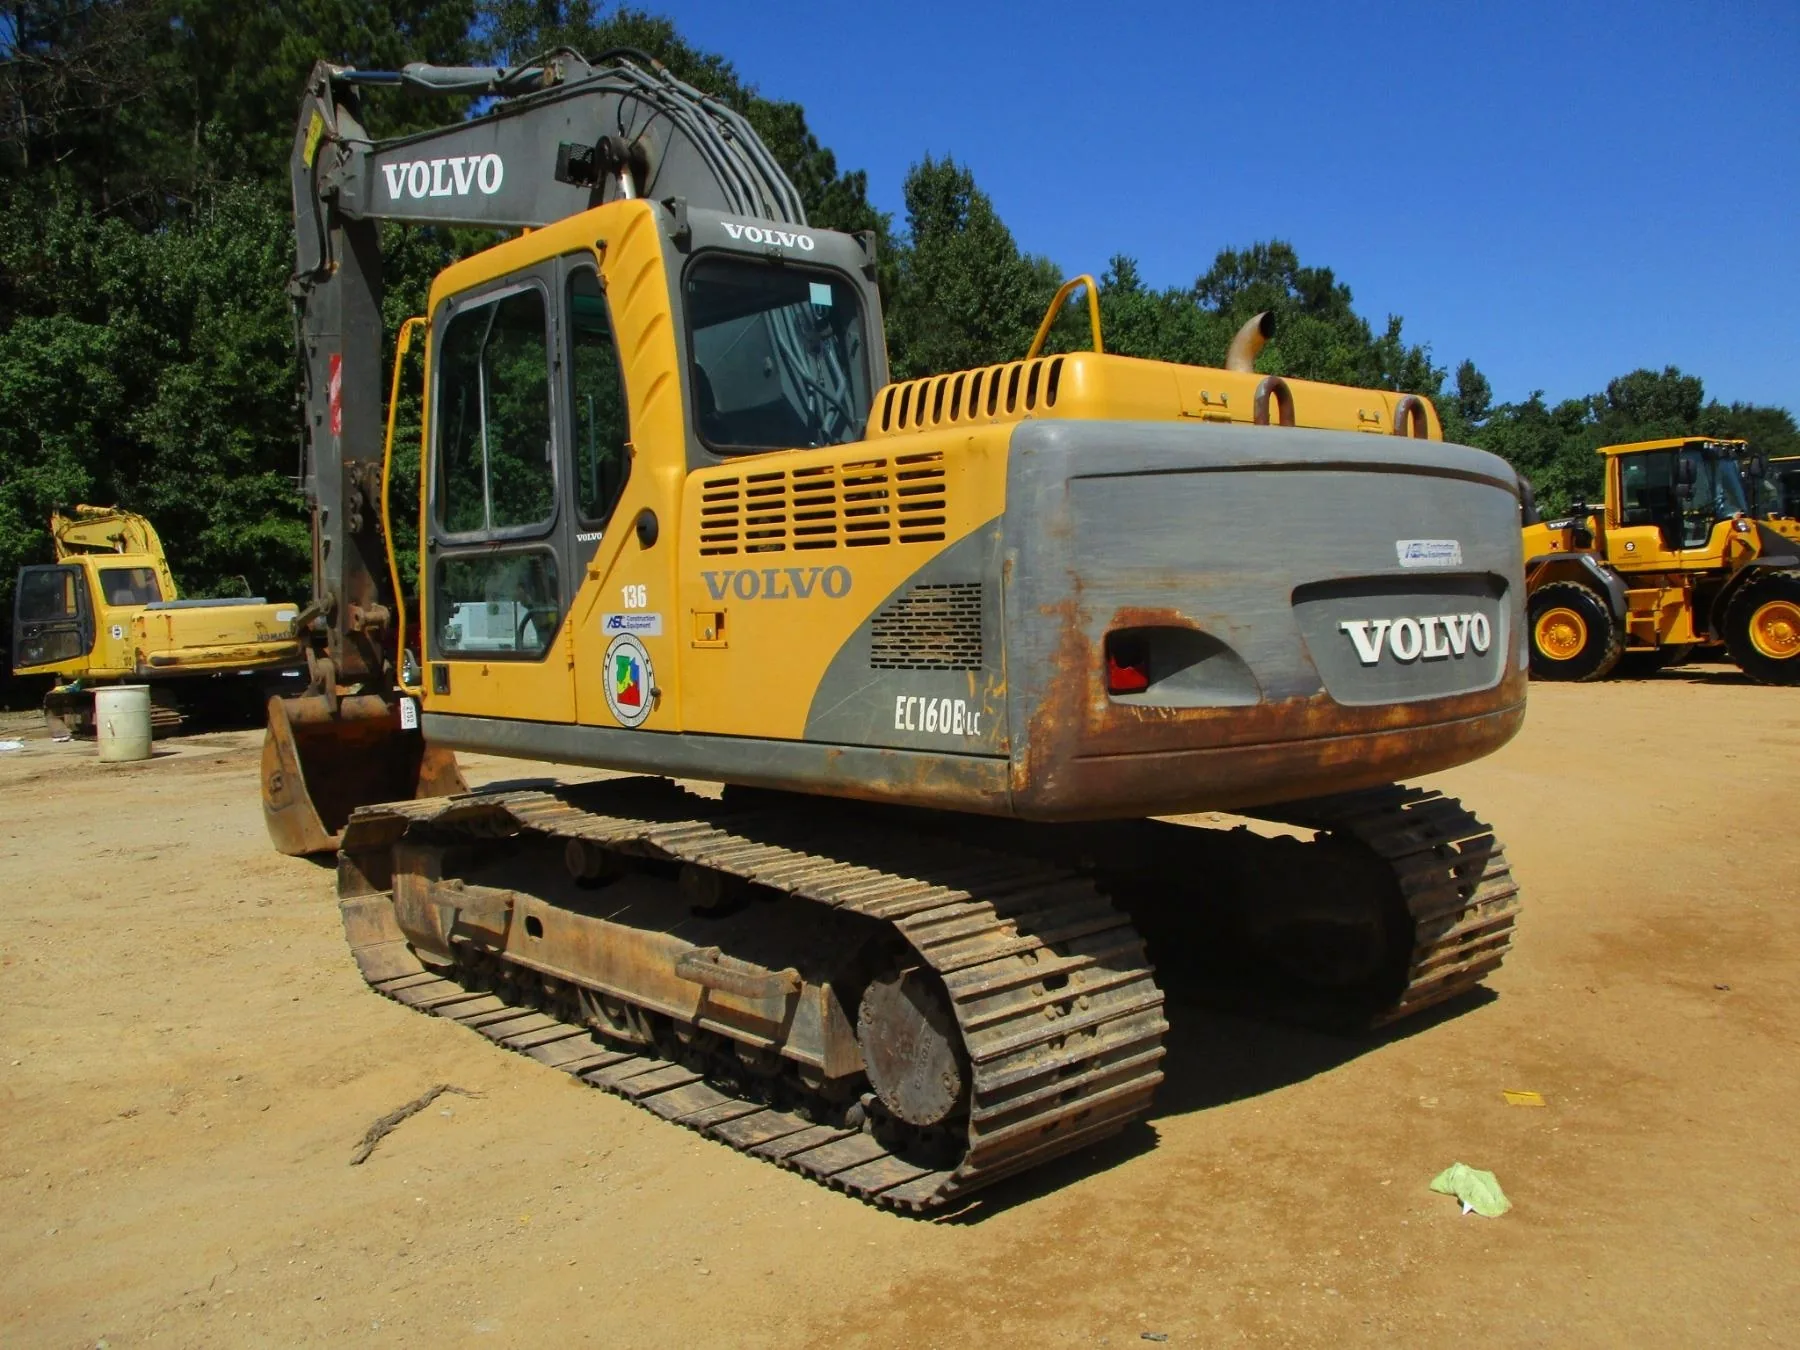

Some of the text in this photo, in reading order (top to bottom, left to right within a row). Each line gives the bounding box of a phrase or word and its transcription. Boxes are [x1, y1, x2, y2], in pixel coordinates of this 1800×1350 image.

[382, 153, 504, 200] VOLVO
[721, 222, 815, 251] VOLVO
[576, 532, 603, 542] VOLVO
[621, 584, 648, 609] 136
[701, 565, 852, 600] VOLVO
[1339, 612, 1491, 664] VOLVO
